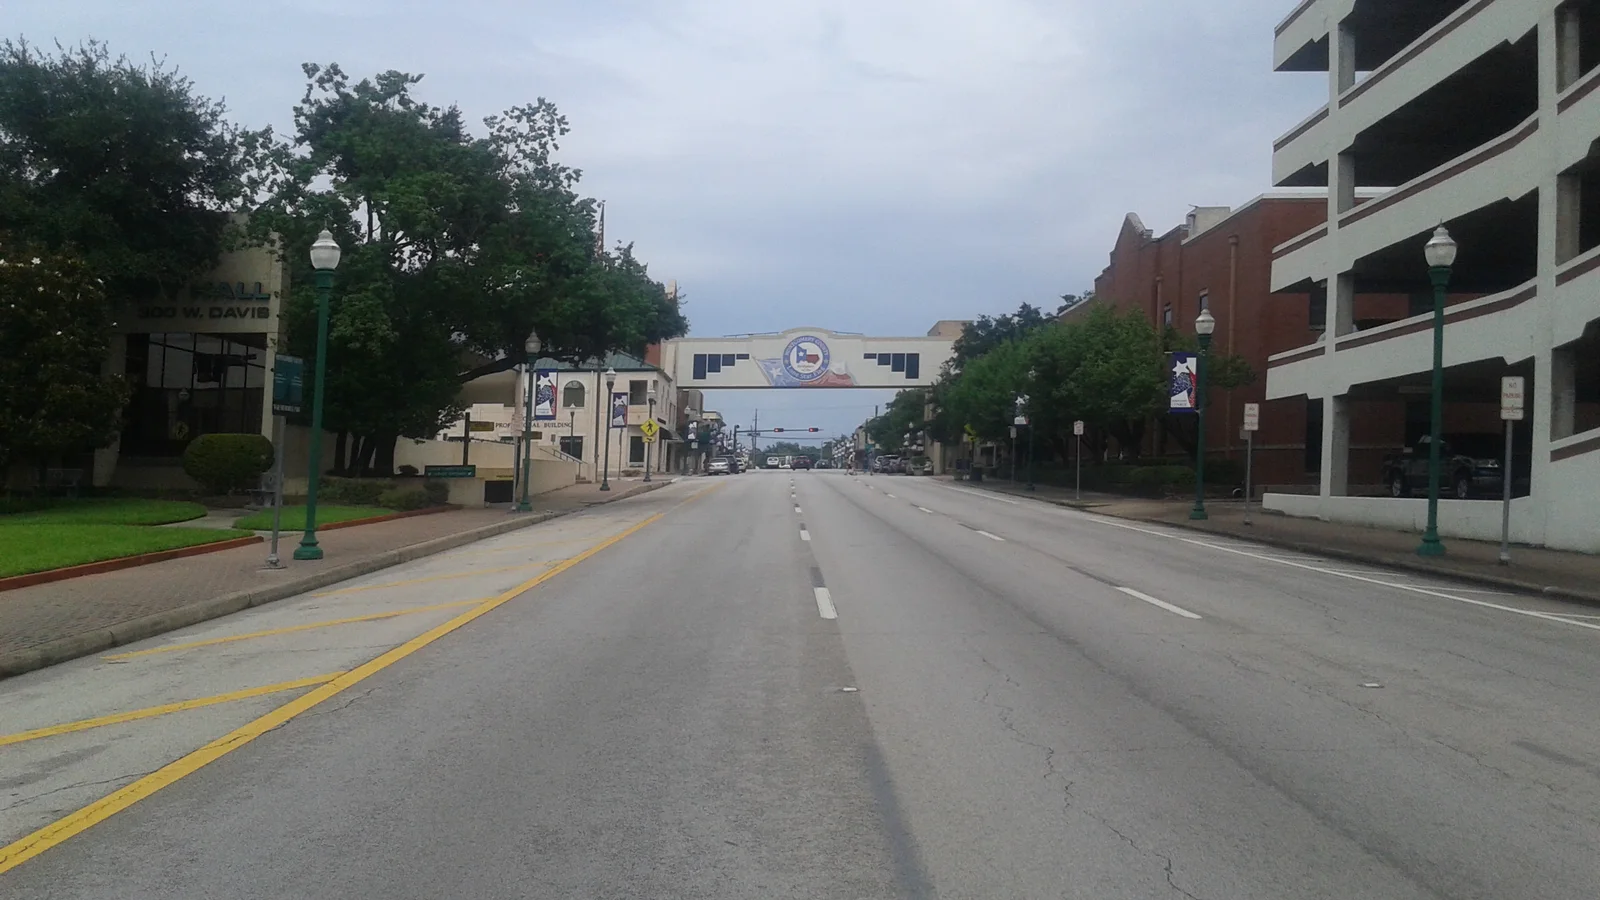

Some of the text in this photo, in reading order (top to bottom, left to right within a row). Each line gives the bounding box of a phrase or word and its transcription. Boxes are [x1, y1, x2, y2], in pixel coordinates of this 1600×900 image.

[202, 281, 271, 300] ALL
[138, 307, 270, 319] 300 W. DAVIS
